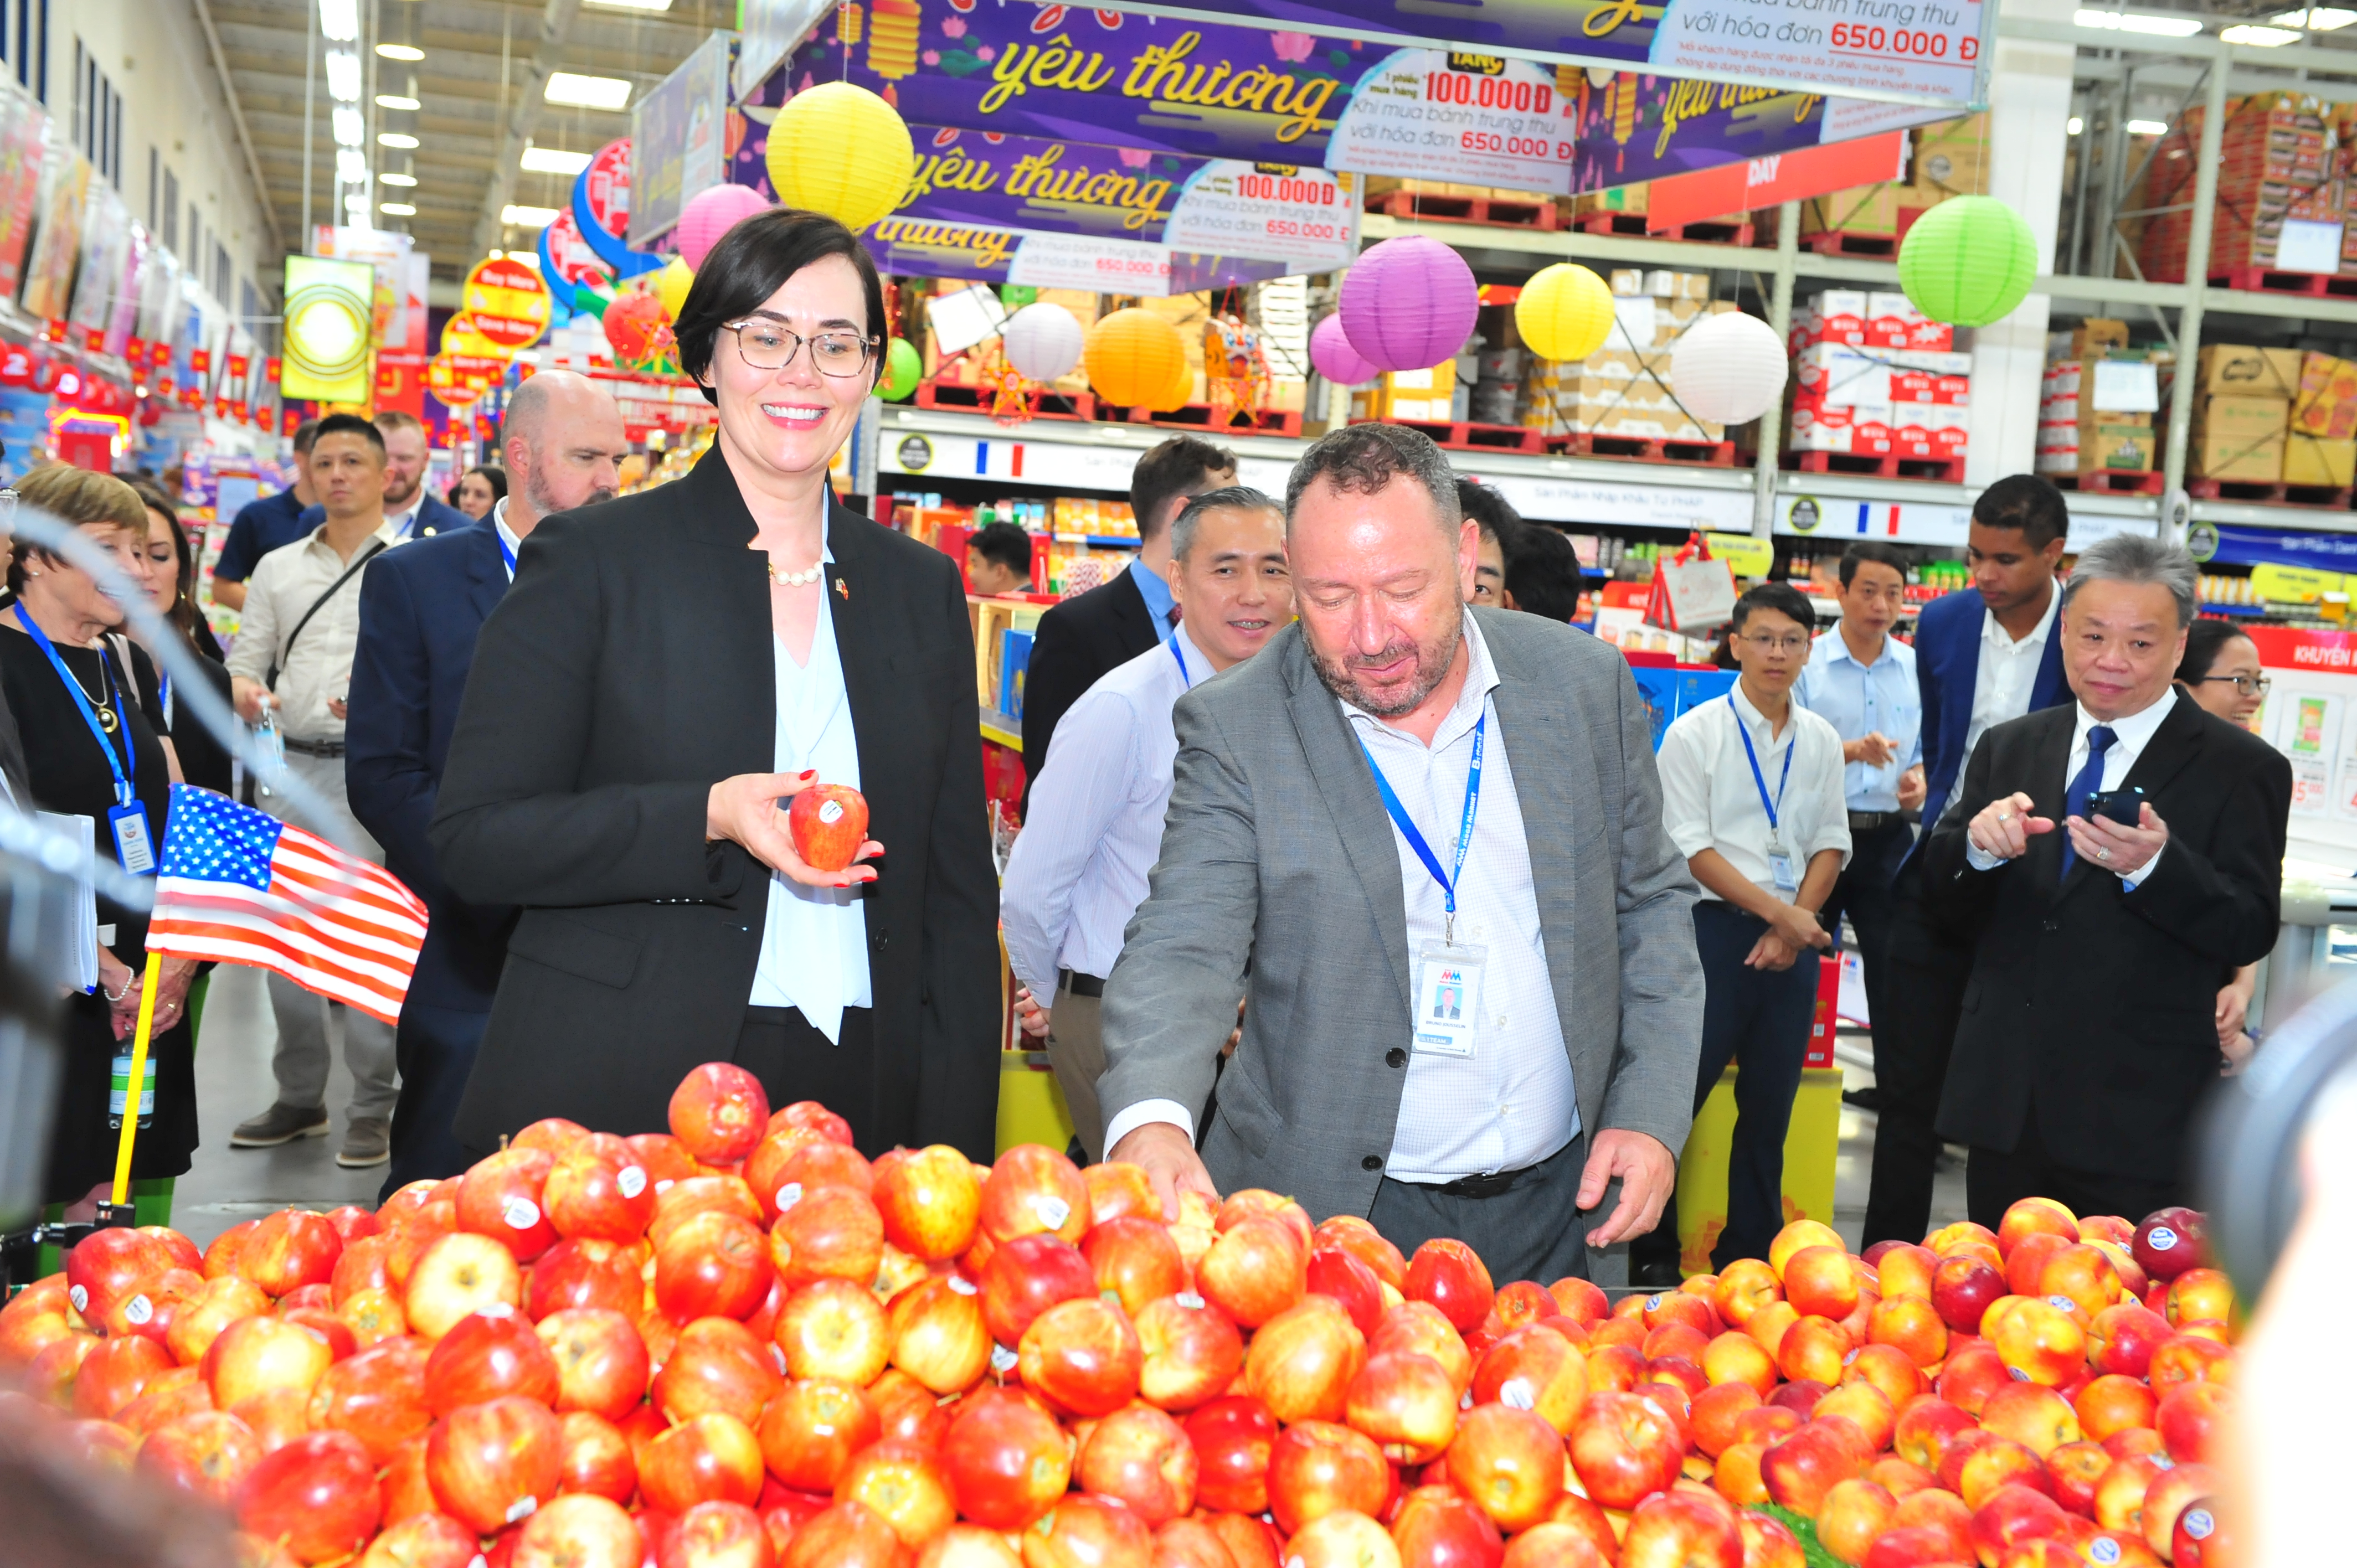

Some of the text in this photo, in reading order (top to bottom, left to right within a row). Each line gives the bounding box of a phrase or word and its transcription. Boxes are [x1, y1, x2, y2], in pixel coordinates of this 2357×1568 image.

[1922, 2, 1959, 26] thu
[1683, 11, 1979, 61] với hóa đơn 650.000 Đ
[979, 31, 1339, 142] yêu thương
[1354, 98, 1557, 135] Khi mua bánh trung thu
[1380, 125, 1416, 143] hóa
[1460, 130, 1548, 157] 650.000
[1004, 143, 1172, 229] thương
[1747, 154, 1782, 193] DAY
[480, 269, 537, 291] Buy More
[506, 321, 537, 337] More
